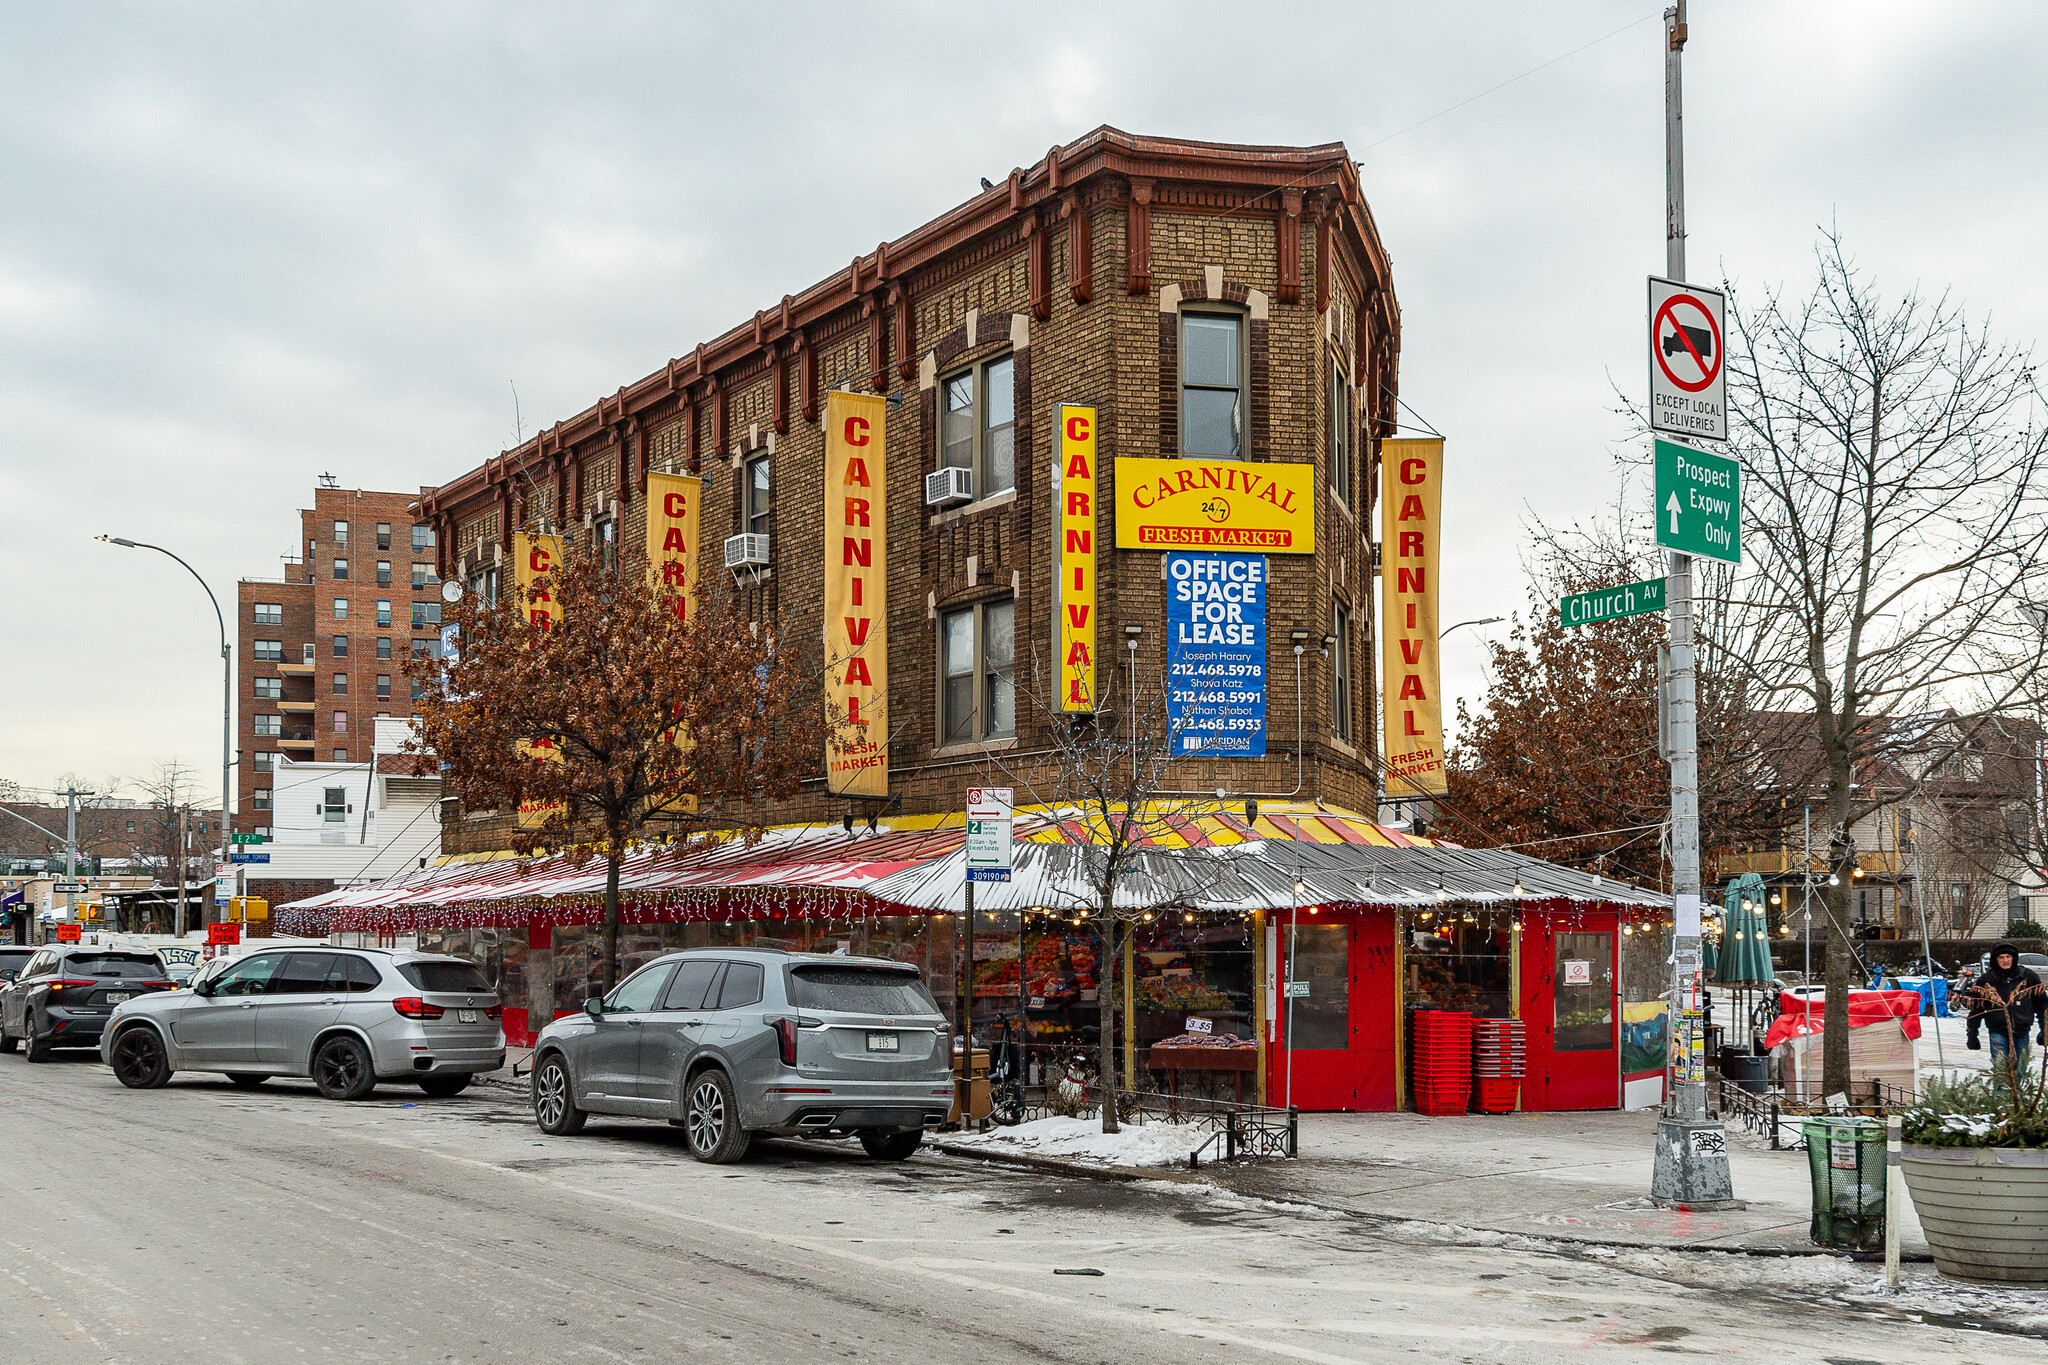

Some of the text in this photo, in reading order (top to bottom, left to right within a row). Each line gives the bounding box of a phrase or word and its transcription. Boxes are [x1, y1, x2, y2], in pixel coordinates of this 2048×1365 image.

[1656, 393, 1721, 416] EXCEPT LOCAL
[1663, 411, 1715, 432] DELIVERIES
[1677, 455, 1731, 489] Prospect
[1132, 467, 1297, 514] CARNIVAL
[1690, 487, 1731, 521] Expwy
[1143, 527, 1289, 546] FRESH MARKET
[1705, 521, 1731, 551] Only
[1066, 416, 1091, 704] CARNIVAL
[1170, 558, 1262, 582] OFFICE
[843, 416, 872, 726] CARNIVAL
[1176, 580, 1256, 603] SPACE
[1398, 458, 1427, 736] CARNIVAL
[1191, 601, 1244, 624] FOR
[1570, 585, 1658, 621] Church Av
[1179, 622, 1255, 645] LEASE
[1183, 651, 1251, 663] Joseph Harary
[1172, 663, 1262, 677] 212.468.5978
[1222, 679, 1243, 688] Katz
[1172, 690, 1261, 704] 212.468.5991
[1181, 705, 1216, 715] Nathan
[1172, 717, 1262, 731] 22.468.5933
[830, 754, 886, 773] MARKET
[1390, 748, 1434, 766] FRESH
[1387, 759, 1443, 780] MARKET
[971, 821, 979, 833] 2
[238, 835, 243, 843] E
[245, 835, 250, 844] 2
[972, 872, 1000, 881] 309190
